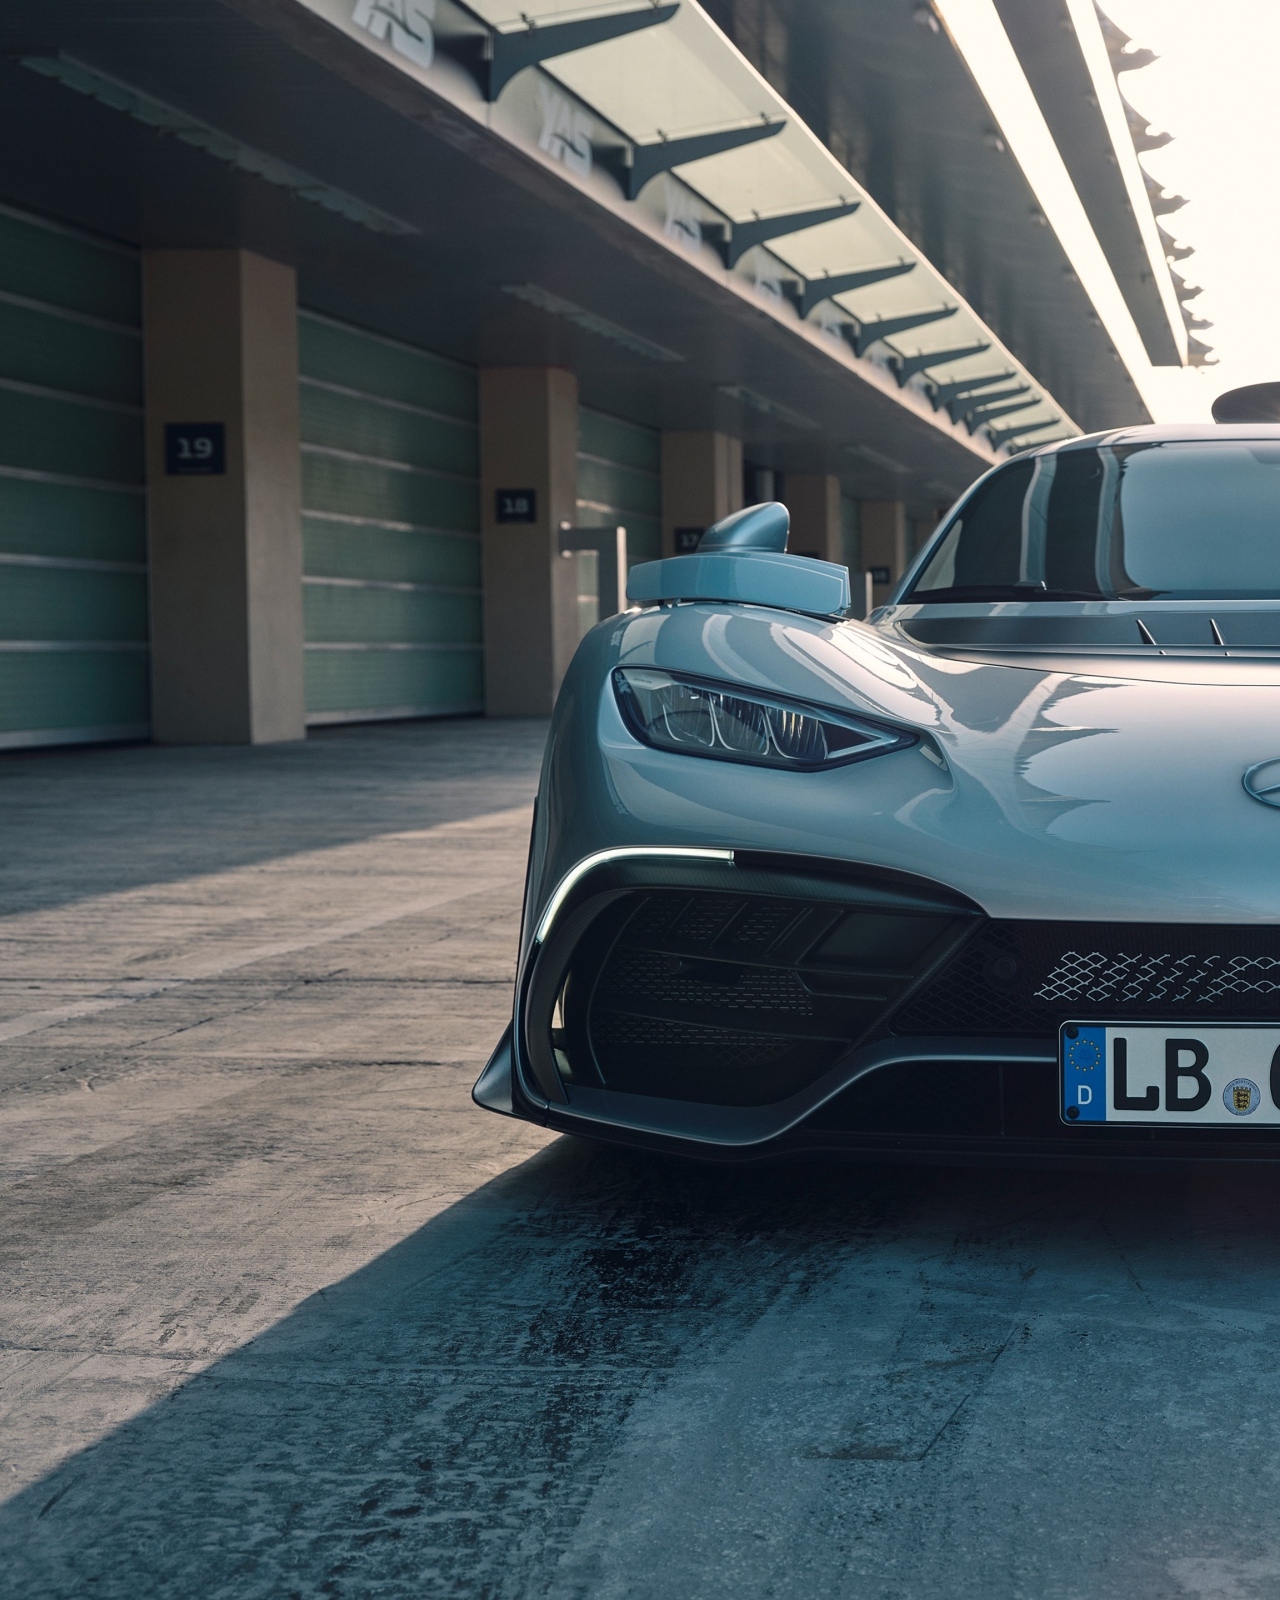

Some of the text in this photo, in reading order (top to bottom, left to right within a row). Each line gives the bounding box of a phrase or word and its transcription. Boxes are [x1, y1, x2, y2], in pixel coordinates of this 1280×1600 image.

[176, 437, 214, 459] 19
[503, 497, 529, 513] 18
[1113, 1037, 1212, 1112] LB
[1077, 1085, 1093, 1105] D
